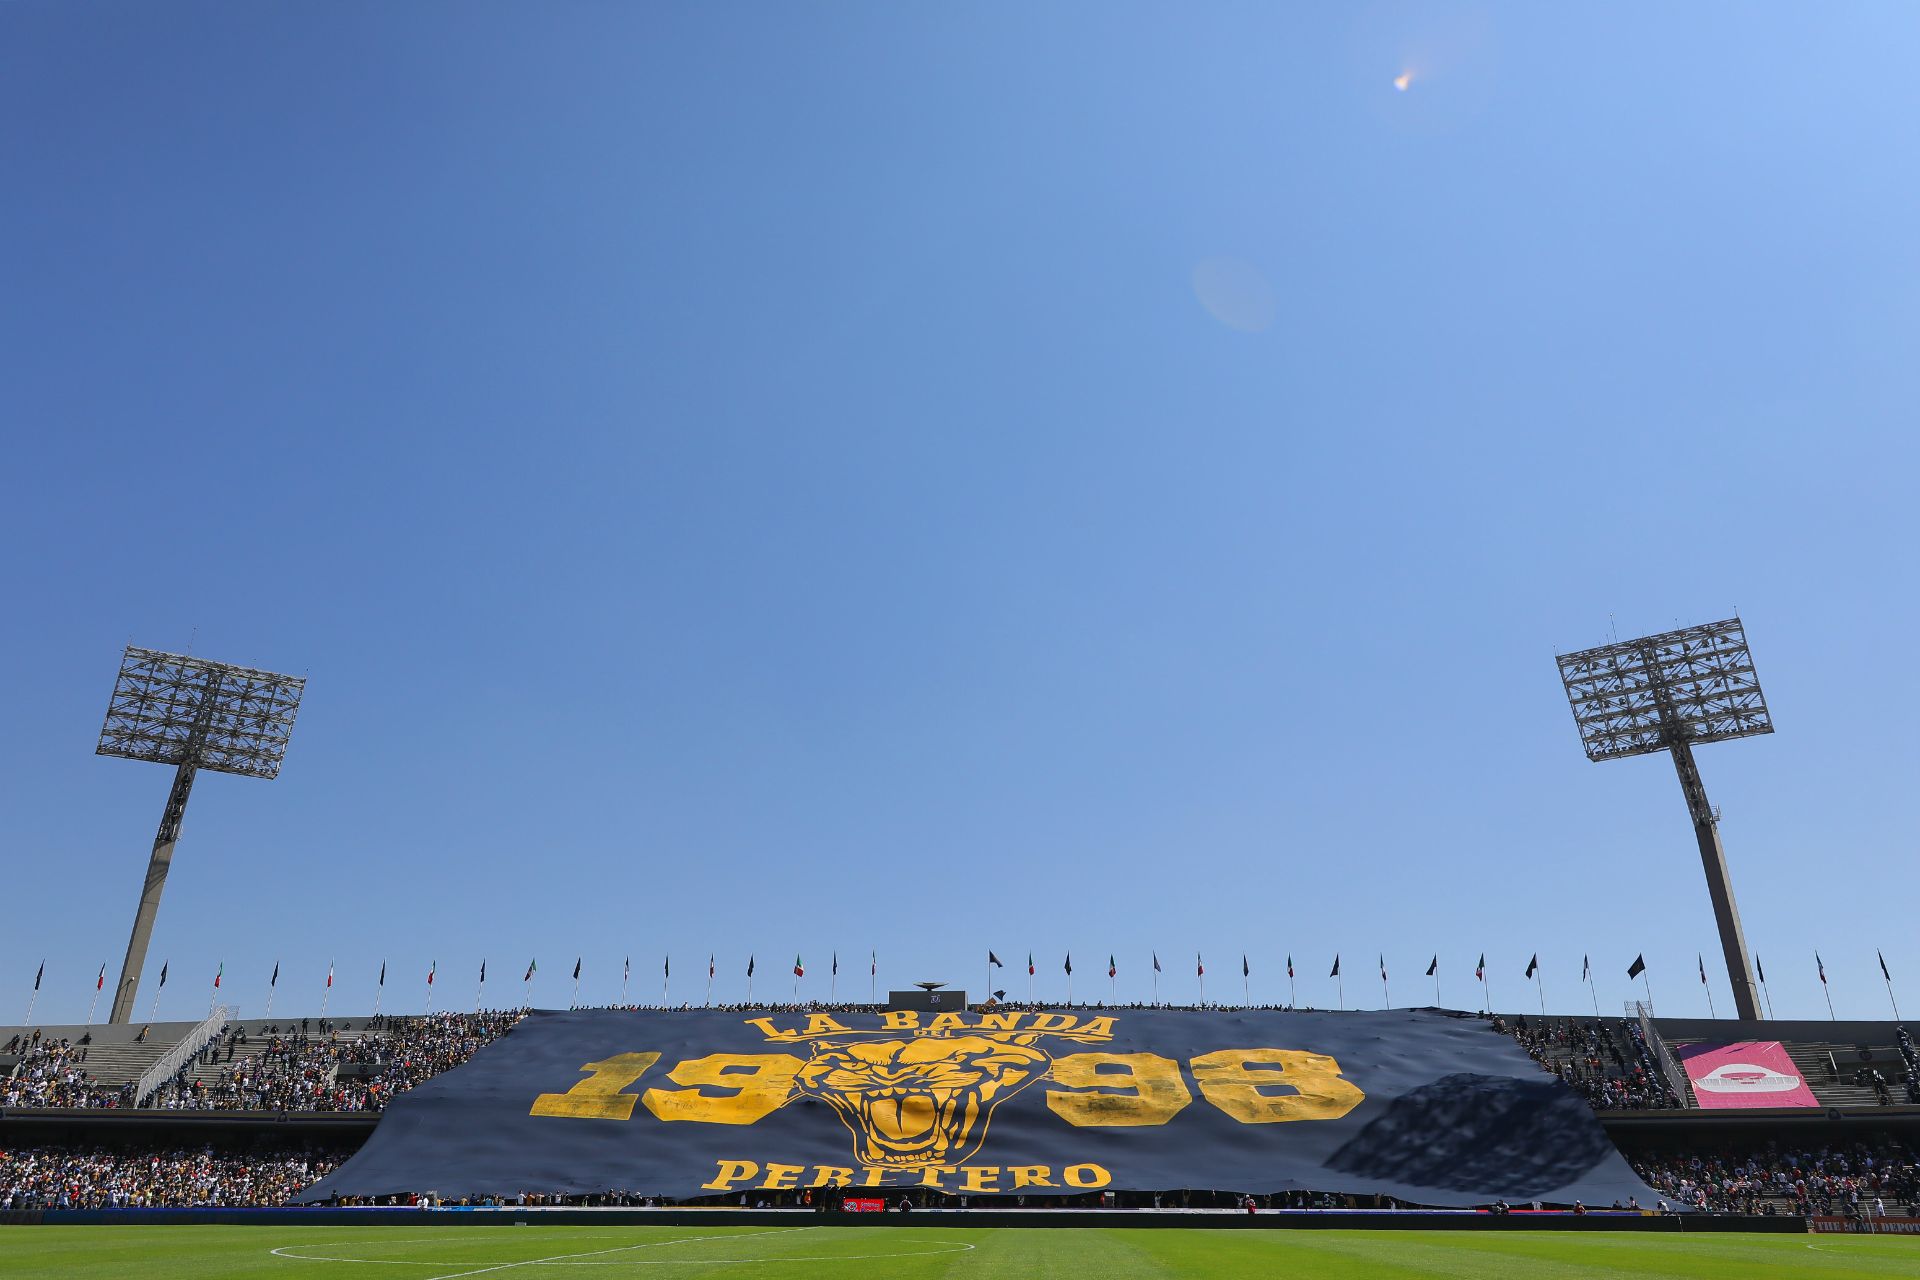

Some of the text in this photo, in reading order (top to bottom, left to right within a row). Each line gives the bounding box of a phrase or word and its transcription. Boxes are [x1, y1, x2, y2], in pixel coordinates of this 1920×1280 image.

[744, 1010, 1120, 1037] LA BANDA
[914, 1029, 956, 1038] DEL
[1816, 1222, 1841, 1231] THE
